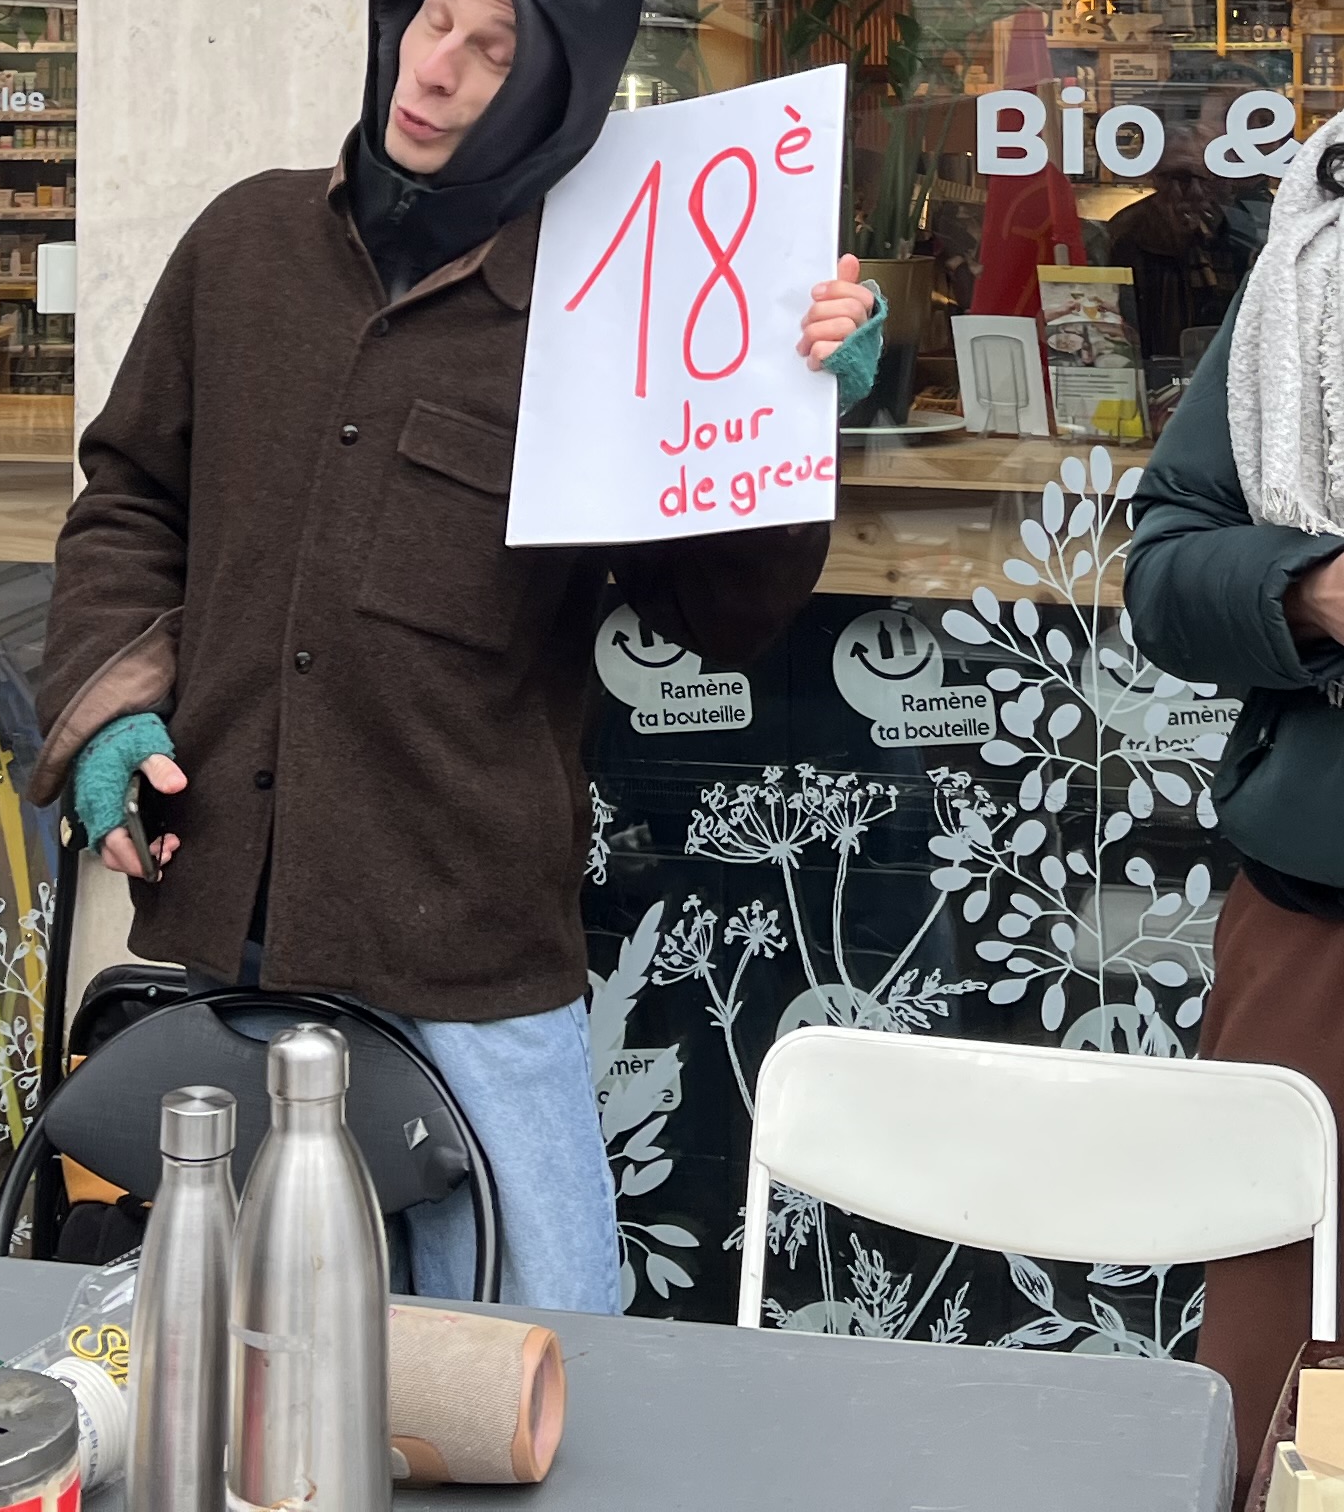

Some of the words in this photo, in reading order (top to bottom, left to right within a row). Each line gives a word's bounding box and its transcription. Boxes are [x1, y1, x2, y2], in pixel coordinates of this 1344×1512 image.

[976, 85, 1166, 178] Bio
[1204, 89, 1304, 180] &
[658, 399, 774, 457] Jour
[658, 464, 717, 518] de
[660, 678, 744, 700] Ramène
[901, 691, 988, 713] Ramène
[636, 711, 659, 728] ta
[662, 704, 746, 726] bouteille
[1167, 704, 1240, 727] amène
[877, 724, 900, 741] ta
[904, 718, 990, 739] bouteille
